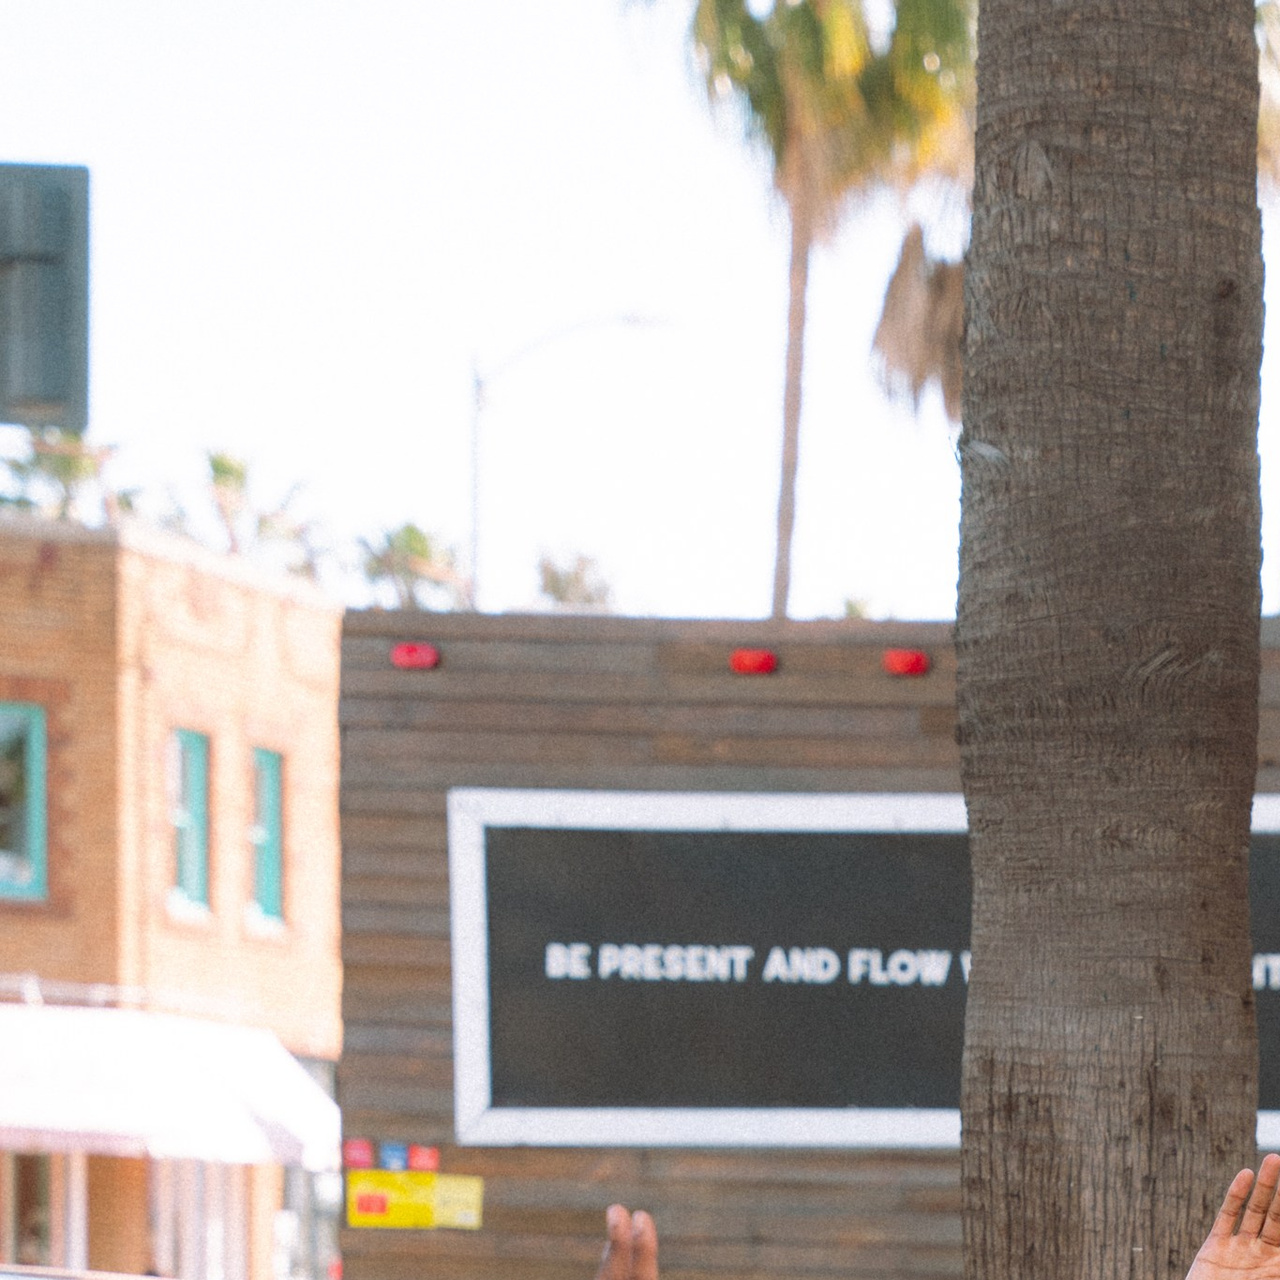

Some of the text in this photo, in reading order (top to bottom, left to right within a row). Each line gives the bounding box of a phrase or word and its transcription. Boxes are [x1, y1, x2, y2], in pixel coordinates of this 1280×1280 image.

[545, 942, 591, 979] BE
[598, 943, 755, 982] PRESENT
[762, 946, 841, 984] AND
[848, 948, 951, 986] FLOW
